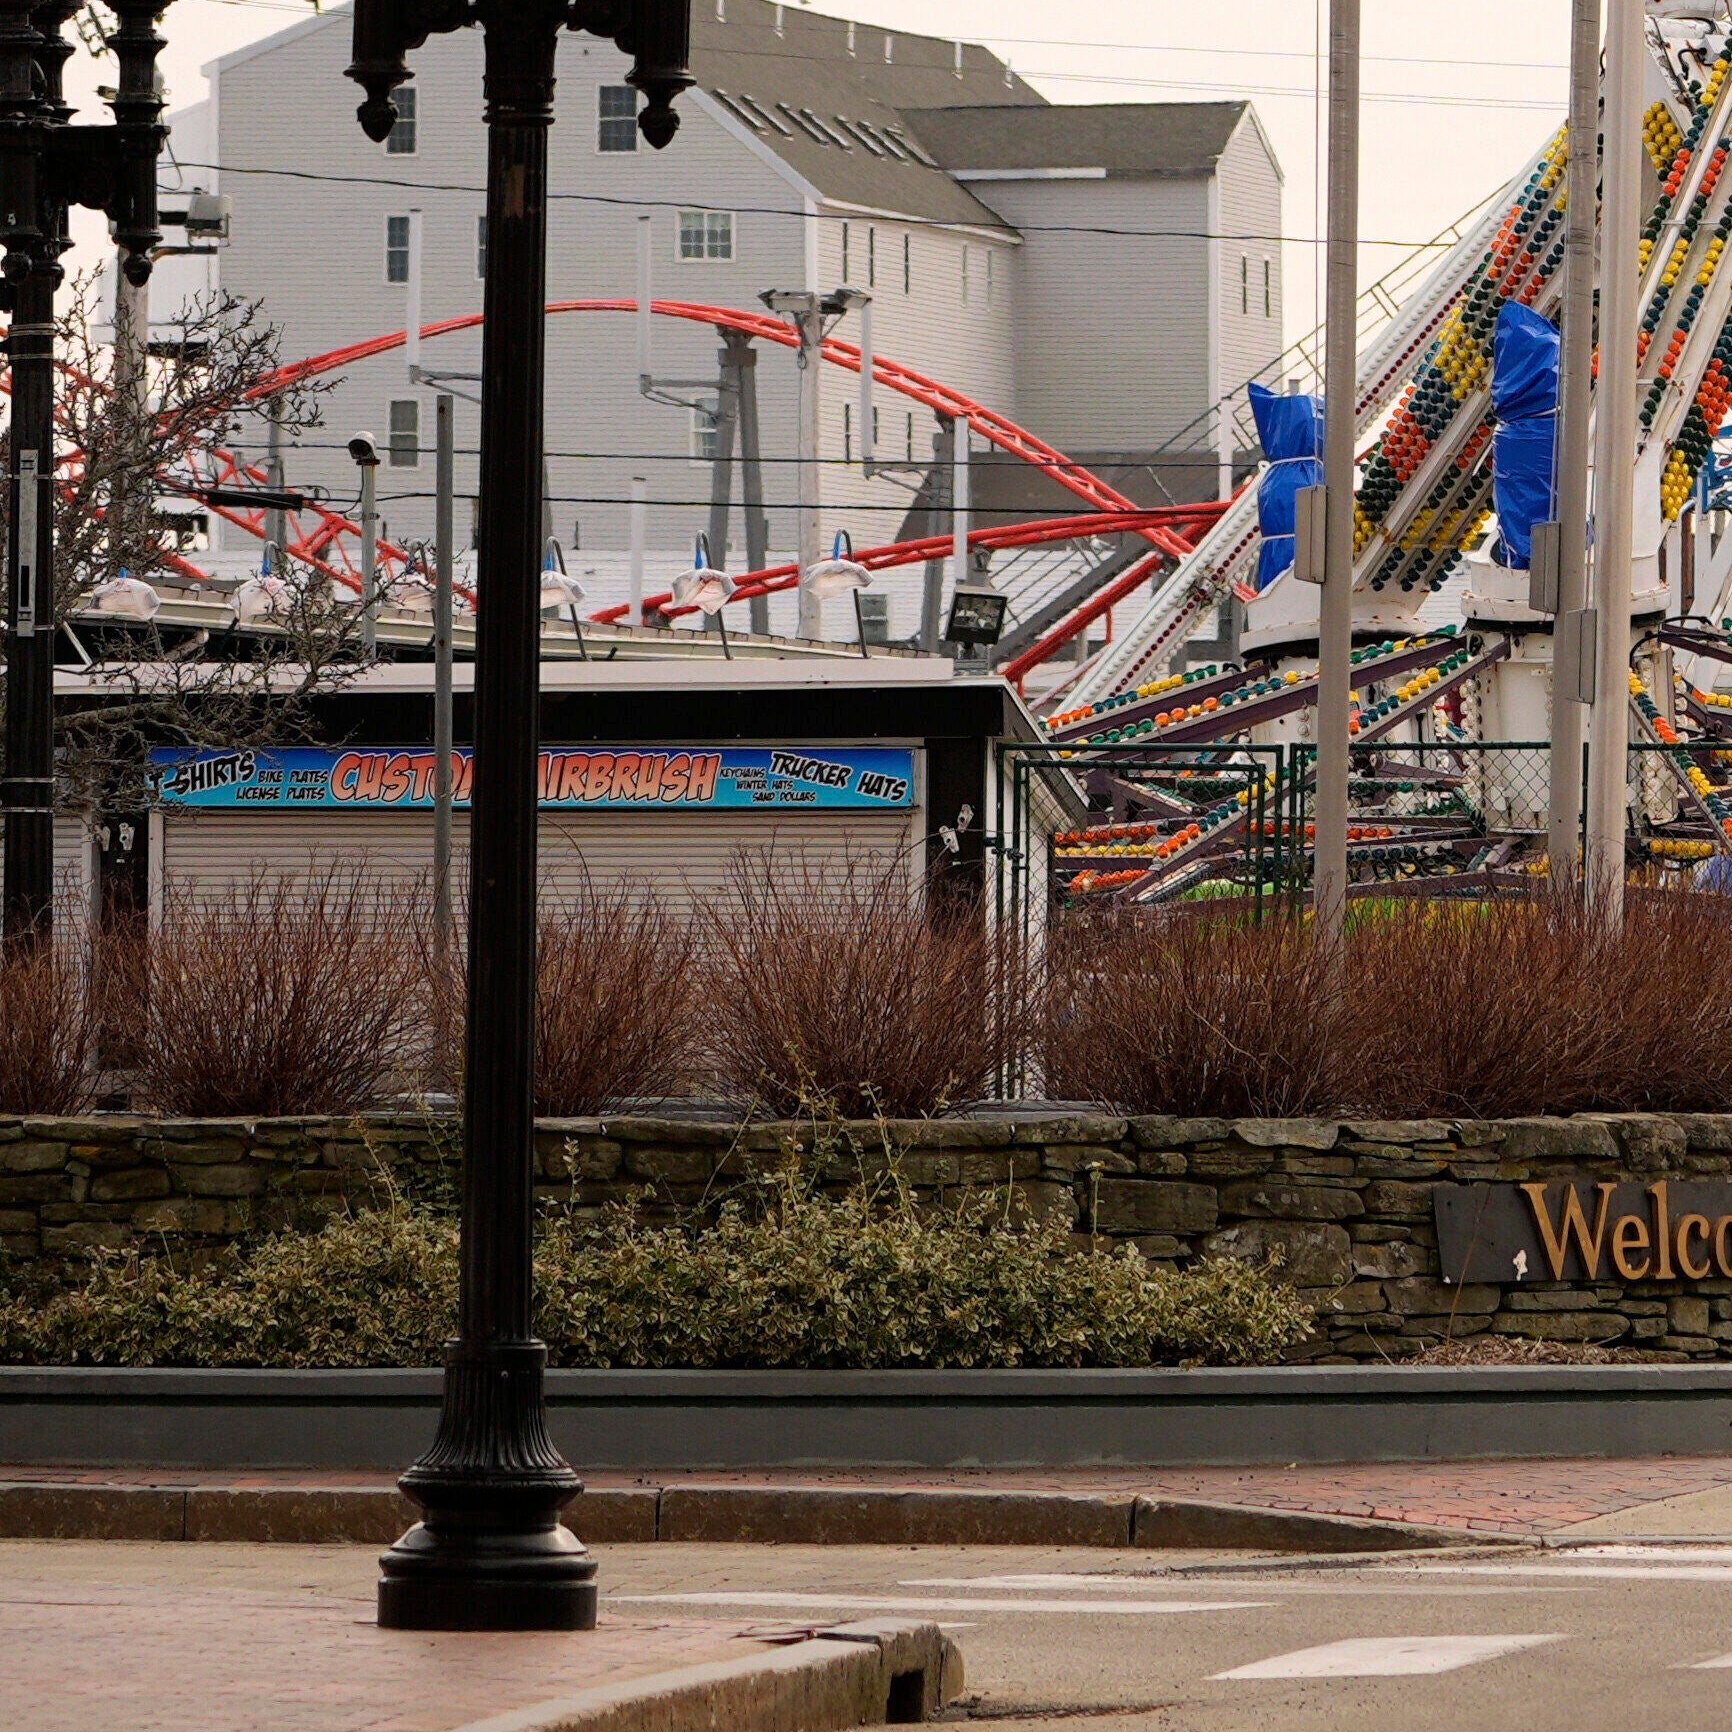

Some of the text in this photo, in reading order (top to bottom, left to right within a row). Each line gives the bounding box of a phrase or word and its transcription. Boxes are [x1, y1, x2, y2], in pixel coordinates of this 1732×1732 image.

[258, 770, 328, 784] BIKE PLATES
[718, 767, 766, 779] KEYCHAINS
[770, 751, 908, 801] TRUCKER HATS
[736, 779, 793, 791] WINTER HATS
[236, 786, 326, 801] LICENSE PLATES
